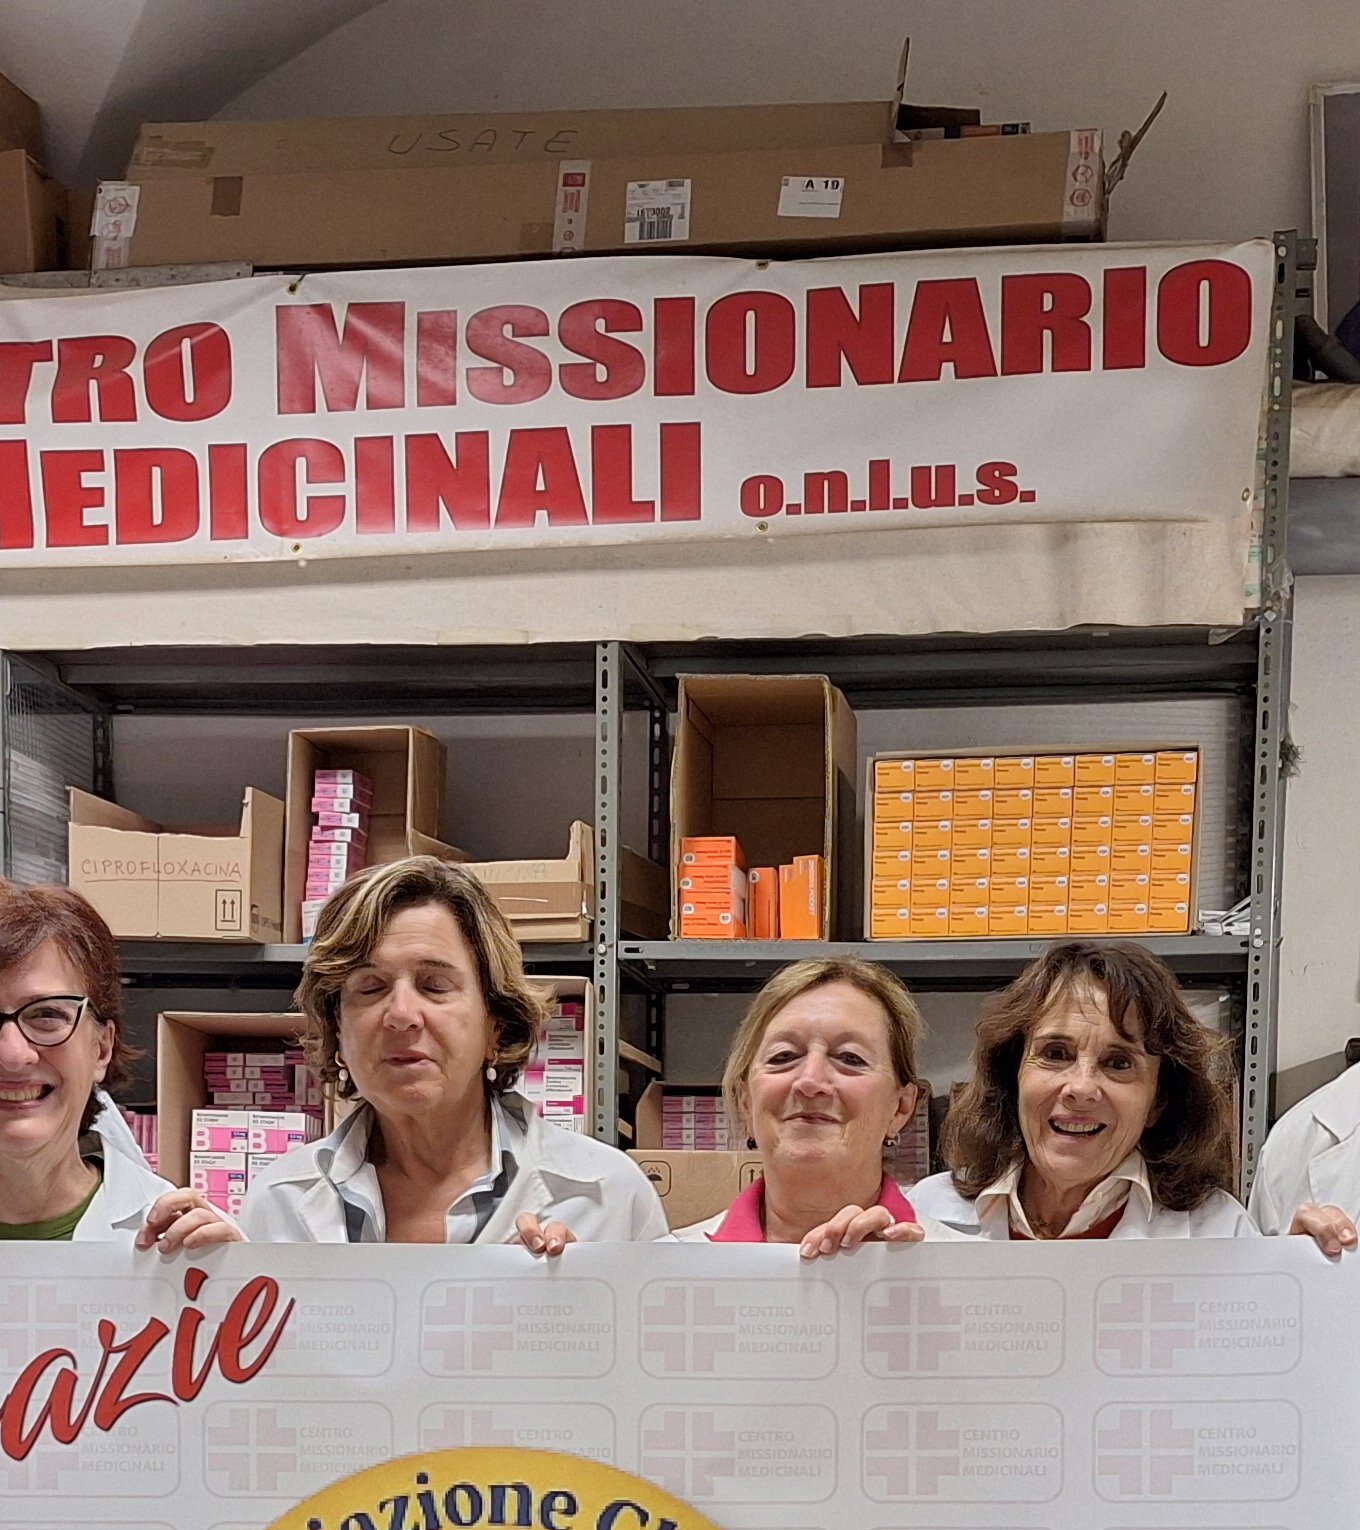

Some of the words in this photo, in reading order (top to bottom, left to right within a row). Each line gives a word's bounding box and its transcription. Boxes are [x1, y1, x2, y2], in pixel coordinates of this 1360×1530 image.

[388, 129, 579, 155] USATE
[804, 179, 814, 190] A
[276, 257, 1254, 416] MISSIONARIO
[740, 456, 1037, 519] o.n.l.u.s.
[80, 858, 242, 880] CIPROFLOXACINA
[299, 1303, 355, 1318] CENTRO
[964, 1303, 1022, 1316] CENTRO
[1198, 1300, 1258, 1313] CENTRO
[299, 1321, 392, 1336] MISSIONARIO
[964, 1320, 1061, 1335] MISSIONARIO
[1198, 1316, 1298, 1331] MISSIONARIO
[299, 1337, 381, 1353] MEDICINALI
[964, 1339, 1049, 1352] MEDICINALI
[1197, 1335, 1286, 1349] MEDICINALI
[963, 1428, 1020, 1442] CENTRO
[1198, 1426, 1257, 1440] CENTRO
[963, 1446, 1059, 1460] MISSIONARIO
[1198, 1443, 1298, 1458] MISSIONARIO
[963, 1464, 1048, 1478] MEDICINALI
[1197, 1462, 1285, 1476] MEDICINALI
